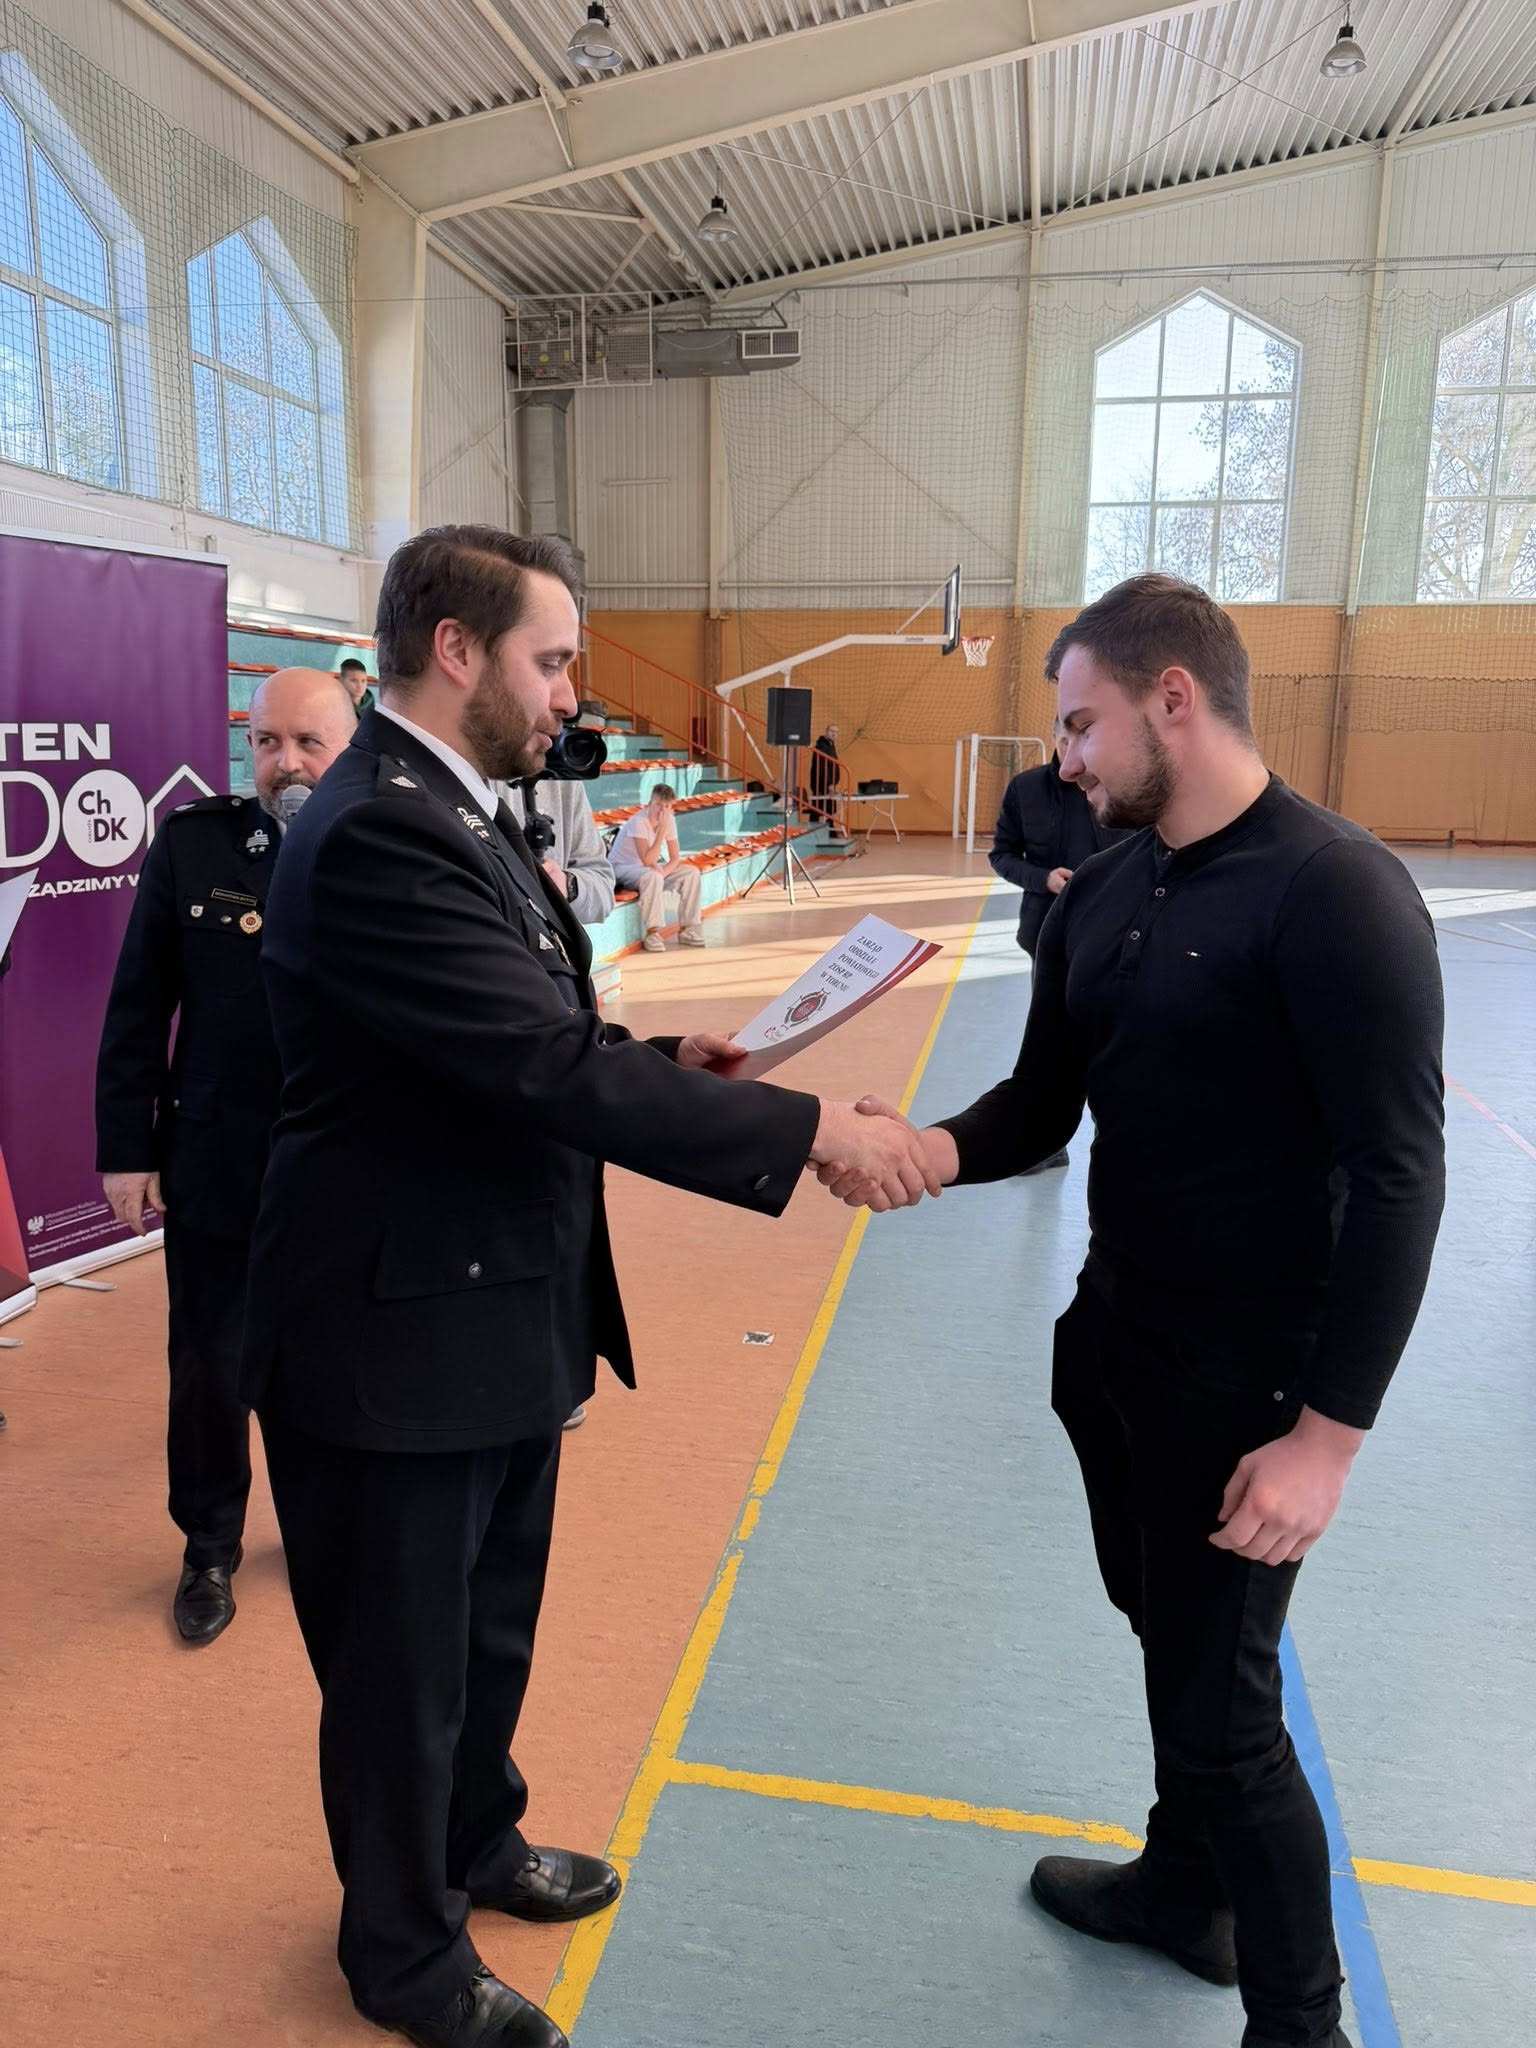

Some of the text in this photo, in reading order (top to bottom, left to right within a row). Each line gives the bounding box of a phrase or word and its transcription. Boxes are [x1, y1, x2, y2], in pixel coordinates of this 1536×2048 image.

[78, 790, 111, 815] Ch
[94, 817, 129, 842] DK
[28, 874, 125, 898] ZĄDZIMY
[857, 936, 883, 953] ZARZĄD
